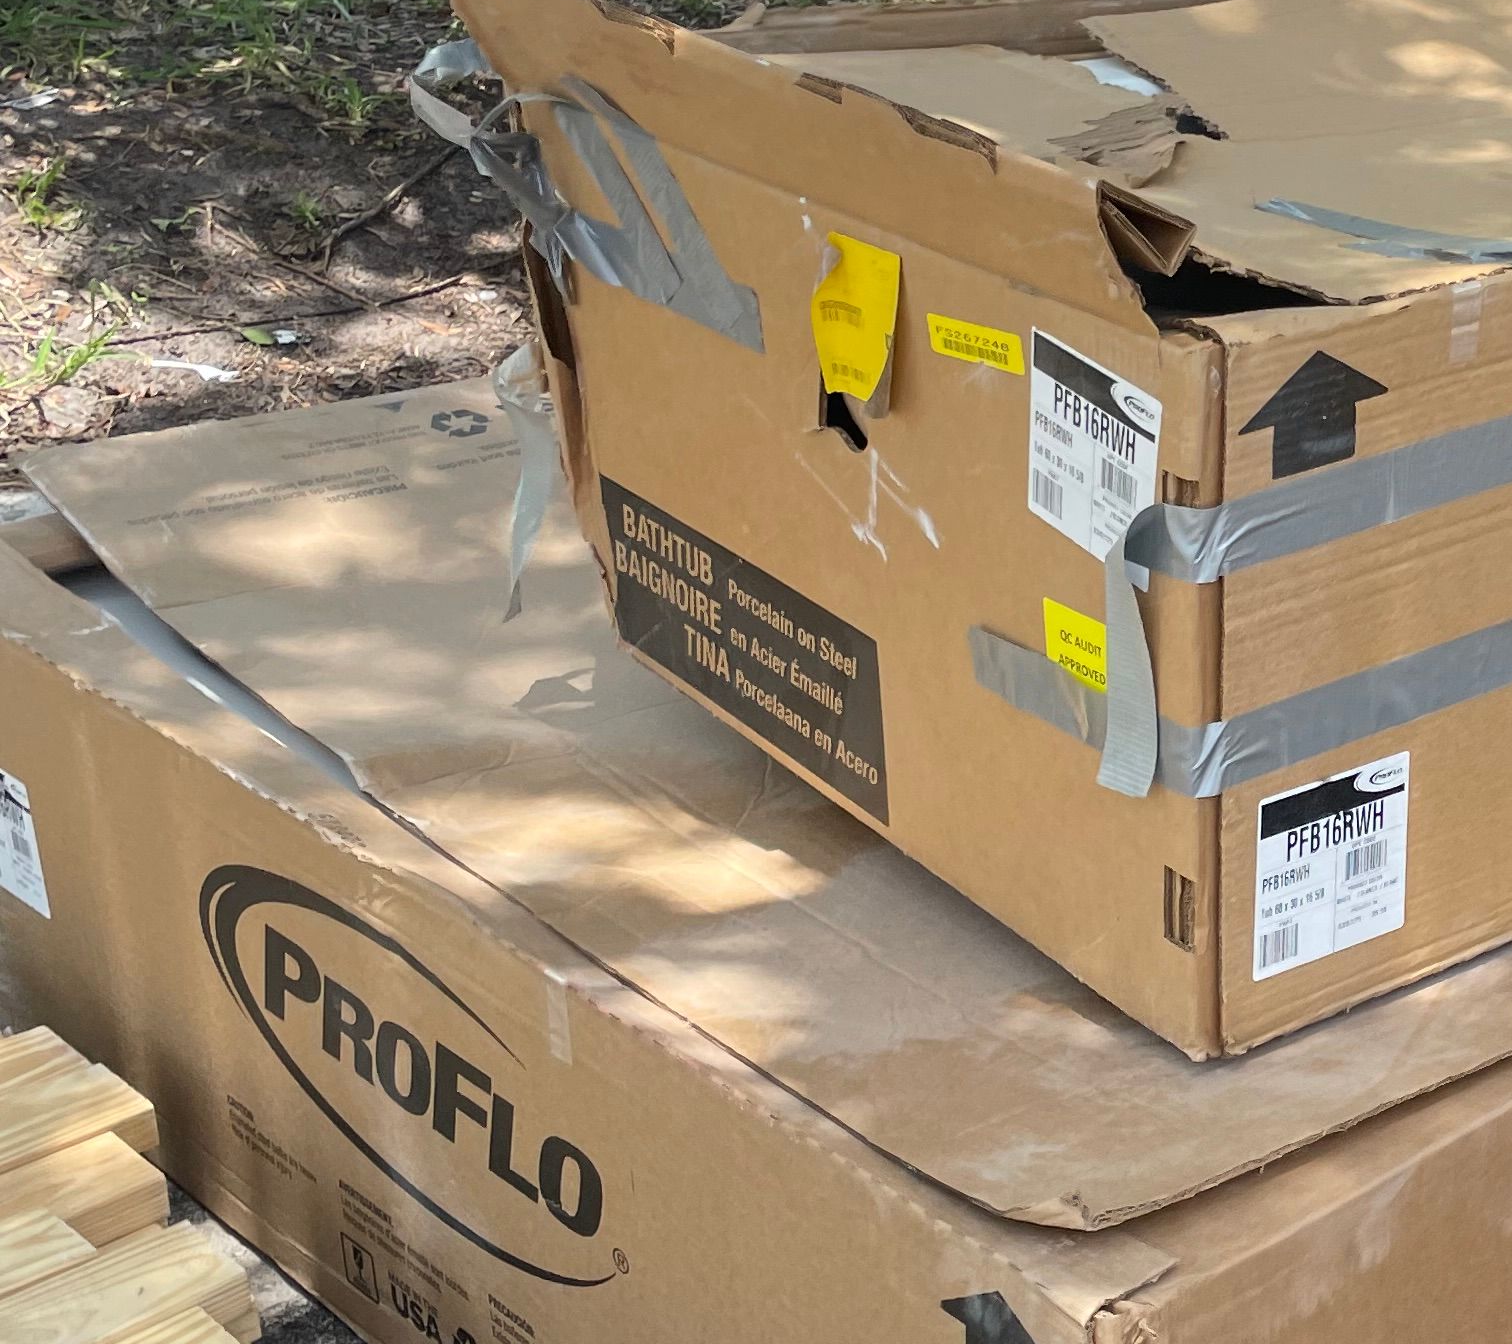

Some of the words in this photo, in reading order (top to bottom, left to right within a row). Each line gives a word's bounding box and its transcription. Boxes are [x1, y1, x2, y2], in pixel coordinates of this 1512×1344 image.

[1054, 382, 1136, 465] PFB16RWH
[614, 539, 722, 635] BAIGNOIRE
[730, 626, 747, 652] en
[750, 636, 787, 678] Acier
[790, 658, 843, 715] Émaillé
[622, 504, 713, 586] BATHTUB
[728, 578, 794, 639] Porcelain
[797, 625, 816, 650] on
[820, 638, 858, 680] Steel
[1058, 654, 1106, 685] APPROVED
[1060, 630, 1072, 644] QC
[1074, 637, 1102, 658] AUDIT
[684, 623, 730, 682] TINA
[736, 668, 810, 738] Porcelaana
[814, 728, 832, 754] en
[836, 740, 878, 784] Acero
[1287, 800, 1384, 862] PFB16RWH
[1262, 864, 1310, 894] PFB16RWH
[265, 923, 602, 1237] PROFLO
